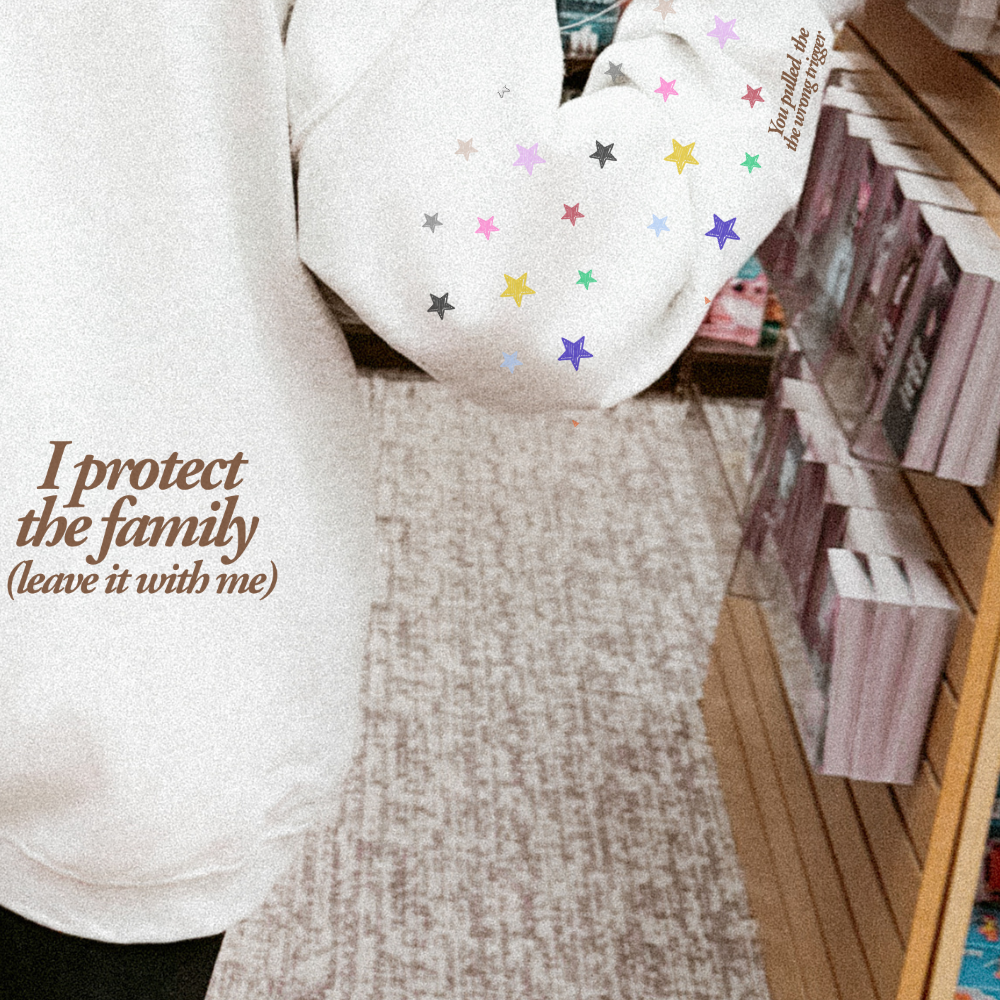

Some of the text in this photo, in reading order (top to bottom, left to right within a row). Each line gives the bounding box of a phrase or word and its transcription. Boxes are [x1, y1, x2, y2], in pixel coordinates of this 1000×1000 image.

[768, 27, 809, 137] You pulled the
[784, 31, 827, 152] the wrong trigger
[37, 441, 249, 508] I protect
[16, 495, 260, 565] the family
[7, 560, 278, 600] (leave it with me)
